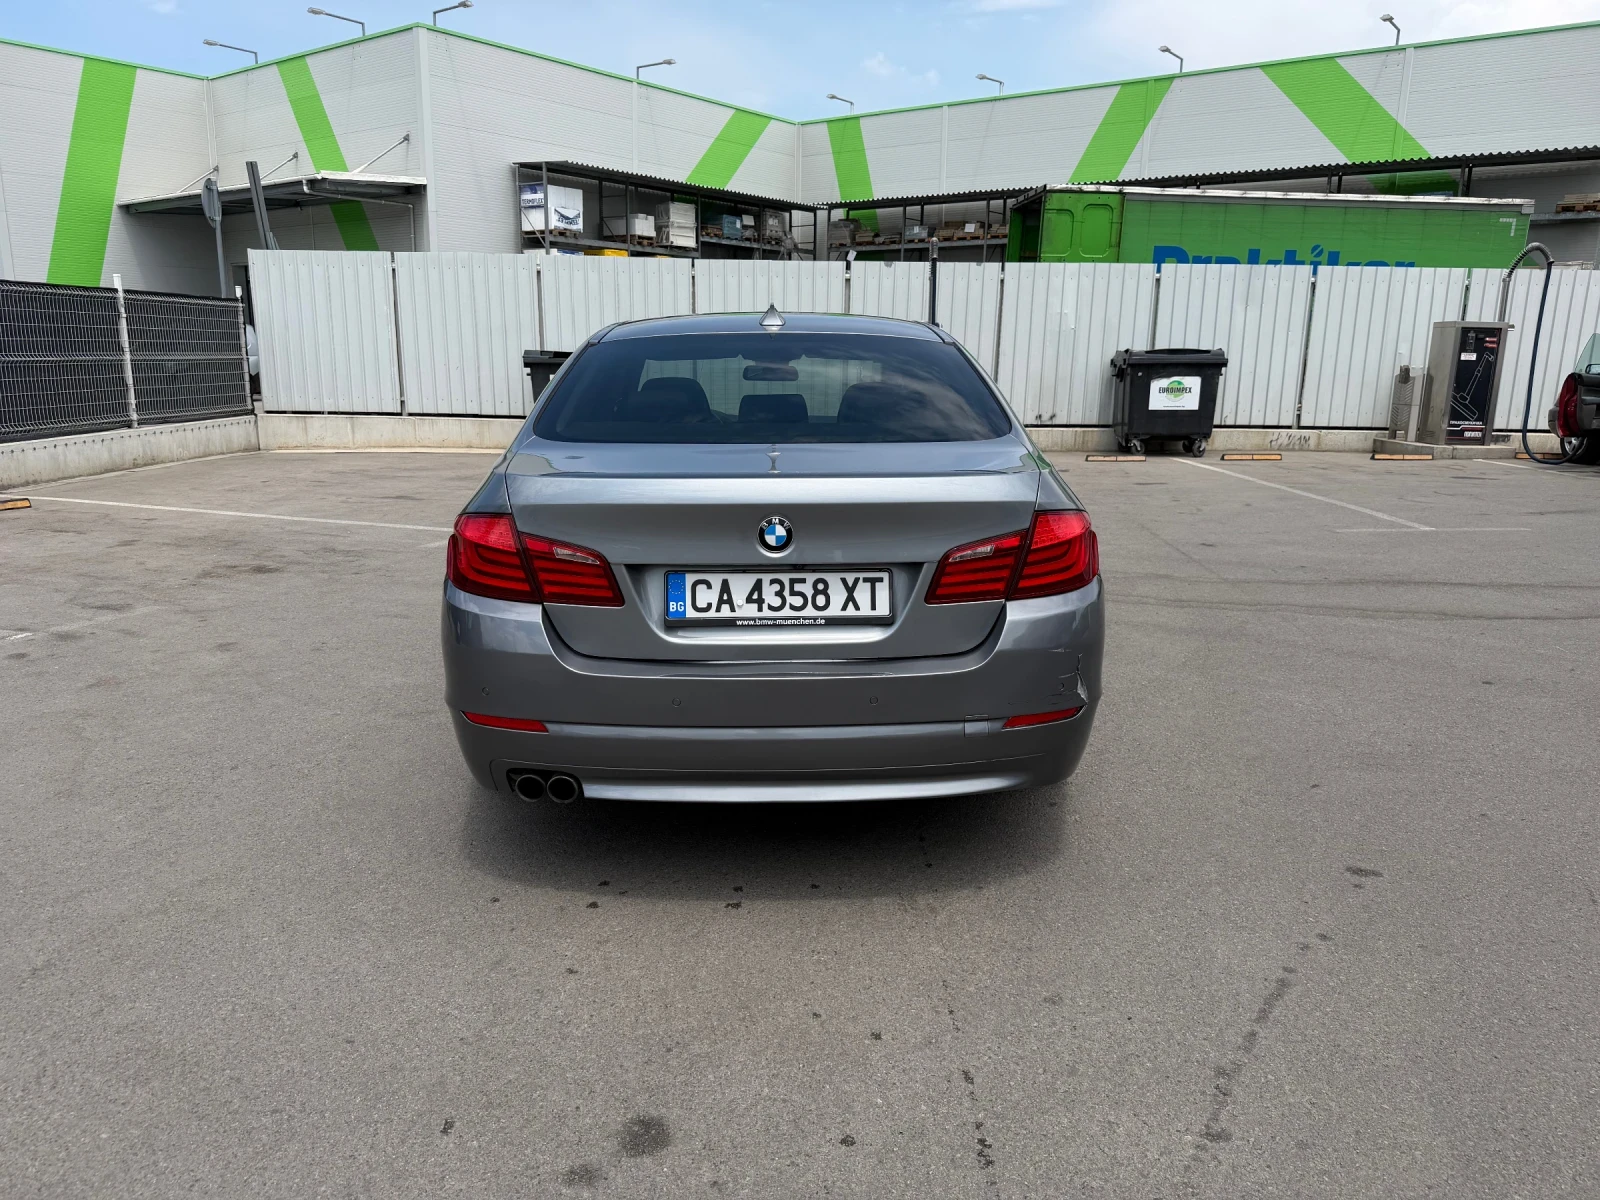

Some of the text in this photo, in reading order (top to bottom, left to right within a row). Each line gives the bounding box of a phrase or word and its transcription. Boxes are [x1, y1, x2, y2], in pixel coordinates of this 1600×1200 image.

[1158, 386, 1193, 394] EUROIMPEX
[690, 576, 884, 613] CA 4358 XT
[669, 601, 685, 612] BG
[736, 617, 826, 626] www.bmw-muenchen.de
